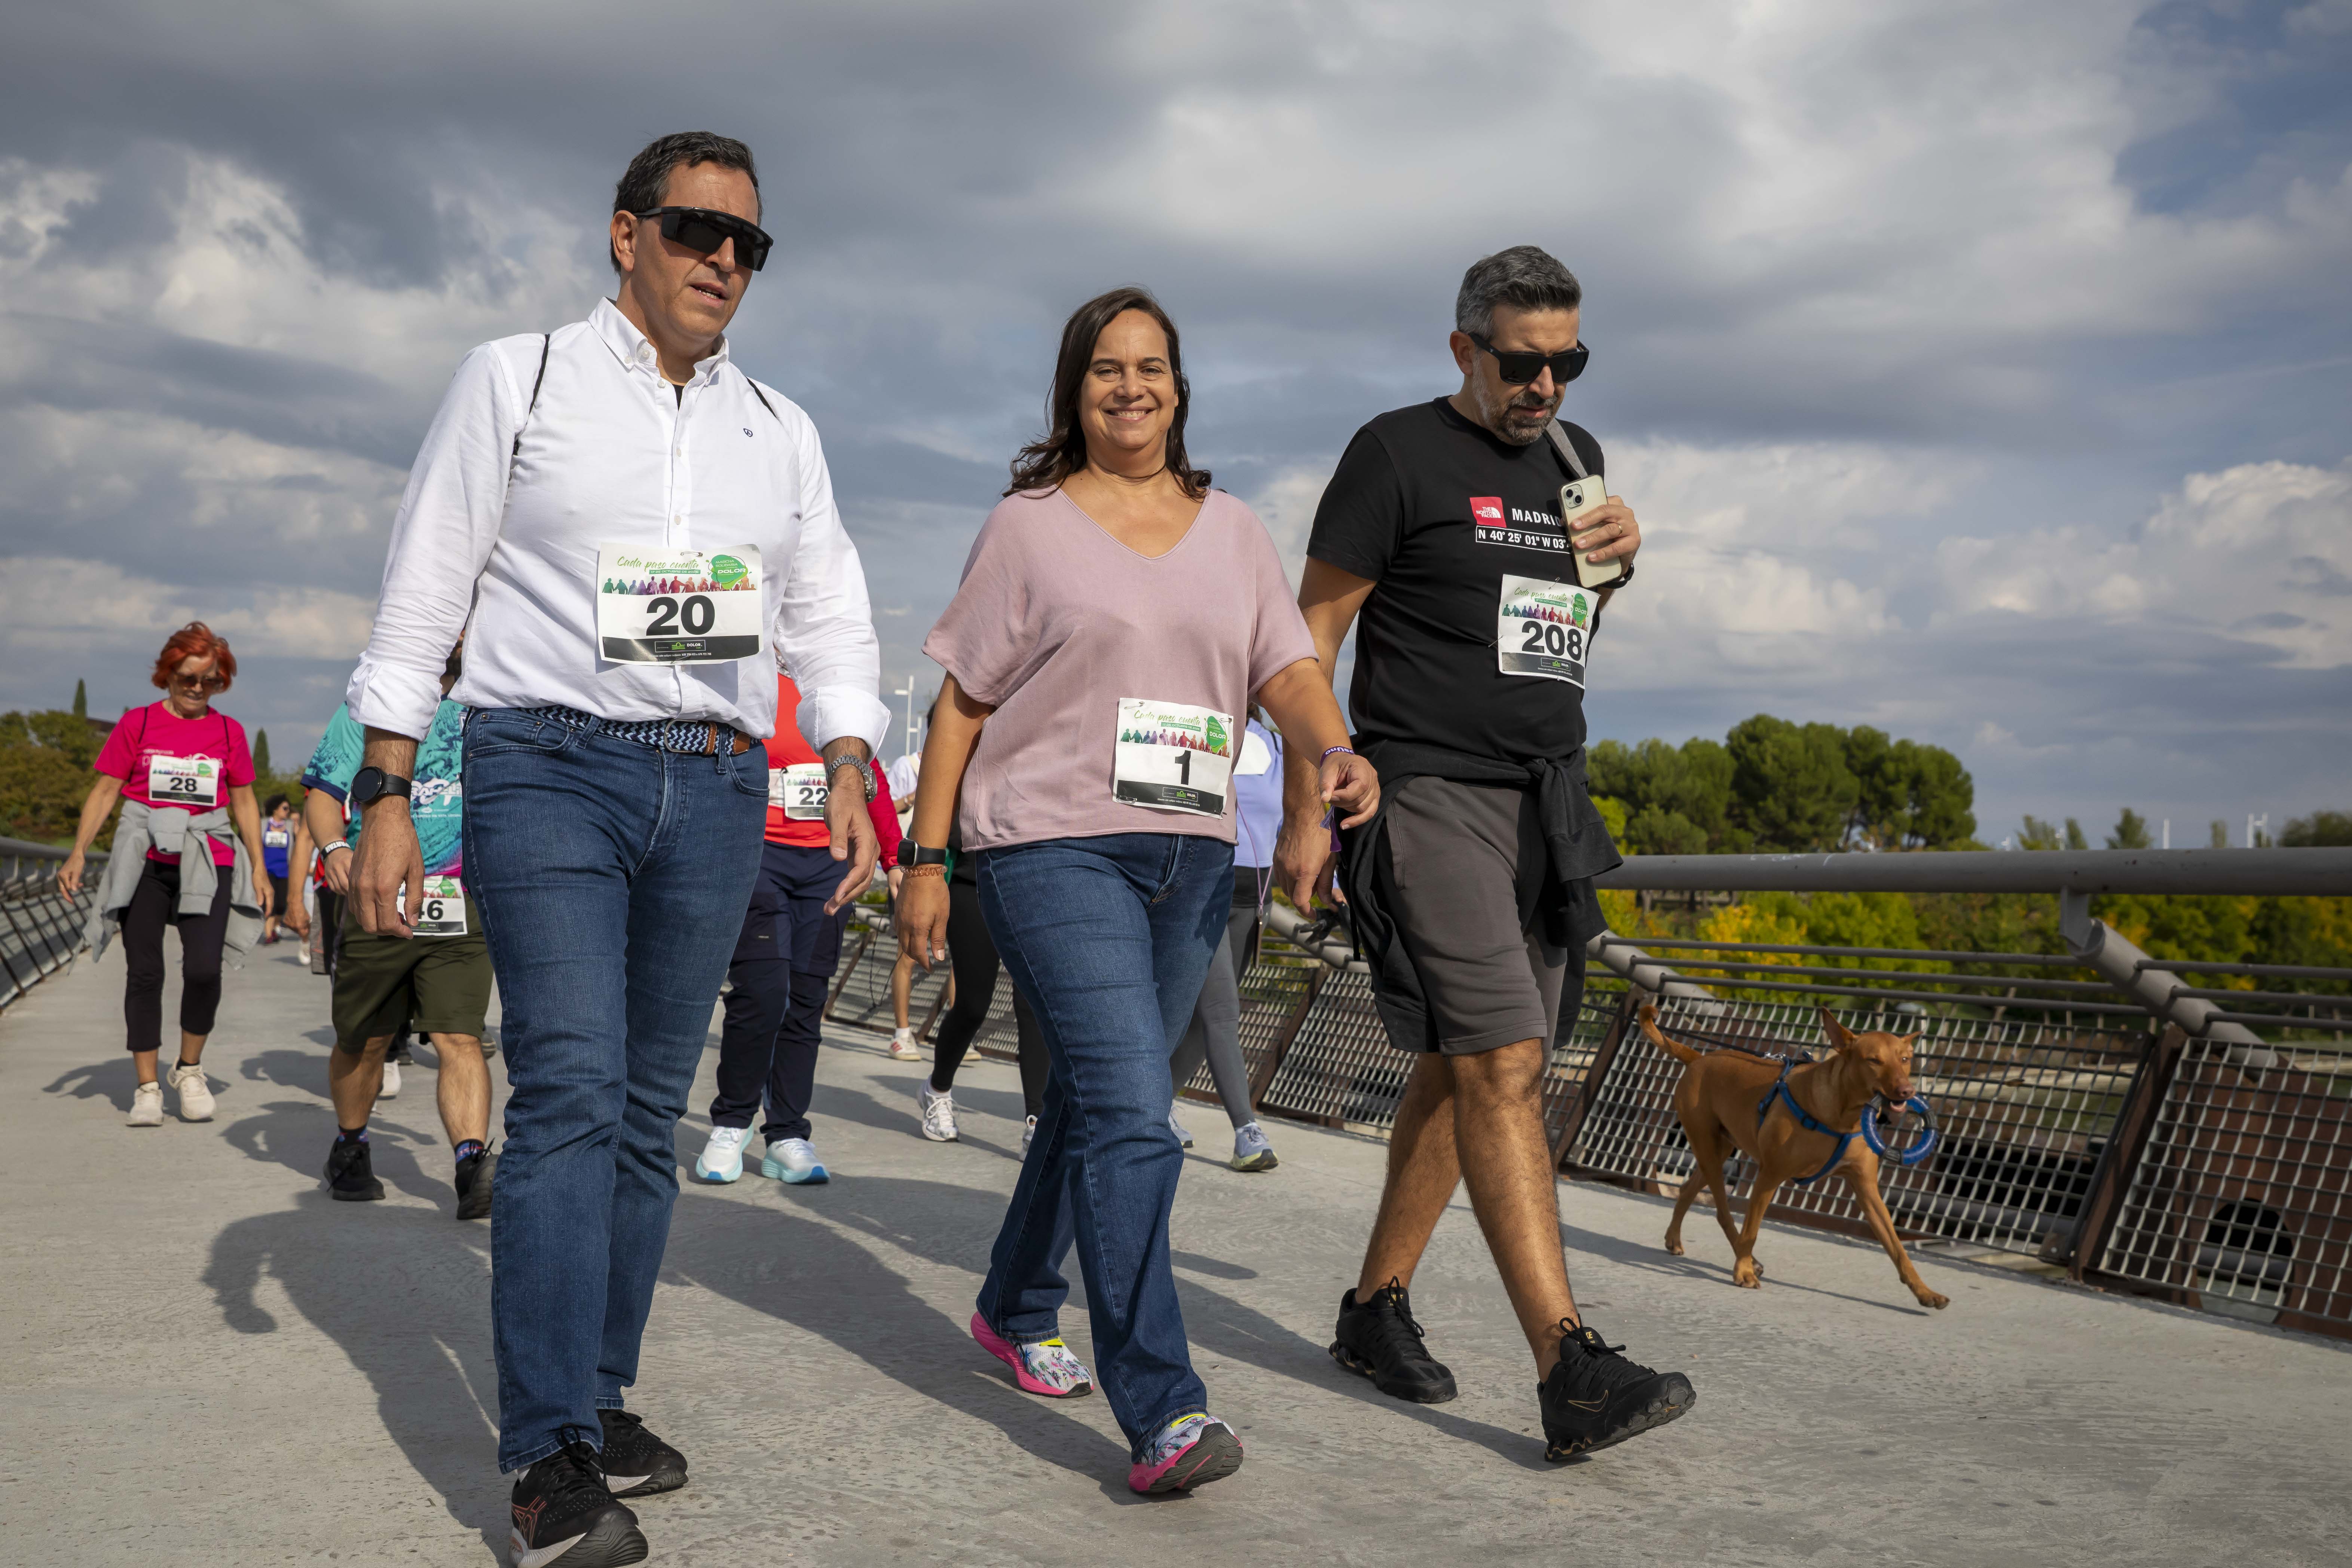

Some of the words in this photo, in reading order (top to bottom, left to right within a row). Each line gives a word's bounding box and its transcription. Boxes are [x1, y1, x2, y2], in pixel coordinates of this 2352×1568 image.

[1478, 529, 1486, 539] N
[1490, 531, 1505, 541] 40°
[1542, 537, 1550, 547] W
[617, 556, 642, 568] Cada
[644, 561, 666, 572] paso
[670, 559, 699, 569] cuenta
[1514, 587, 1529, 596] Cada
[646, 595, 715, 636] 20
[1521, 620, 1582, 661] 208
[1134, 710, 1155, 720] Cada
[1157, 715, 1175, 724] paso
[1179, 716, 1200, 725] cuenta
[1175, 750, 1191, 785] 1
[170, 777, 197, 792] 28
